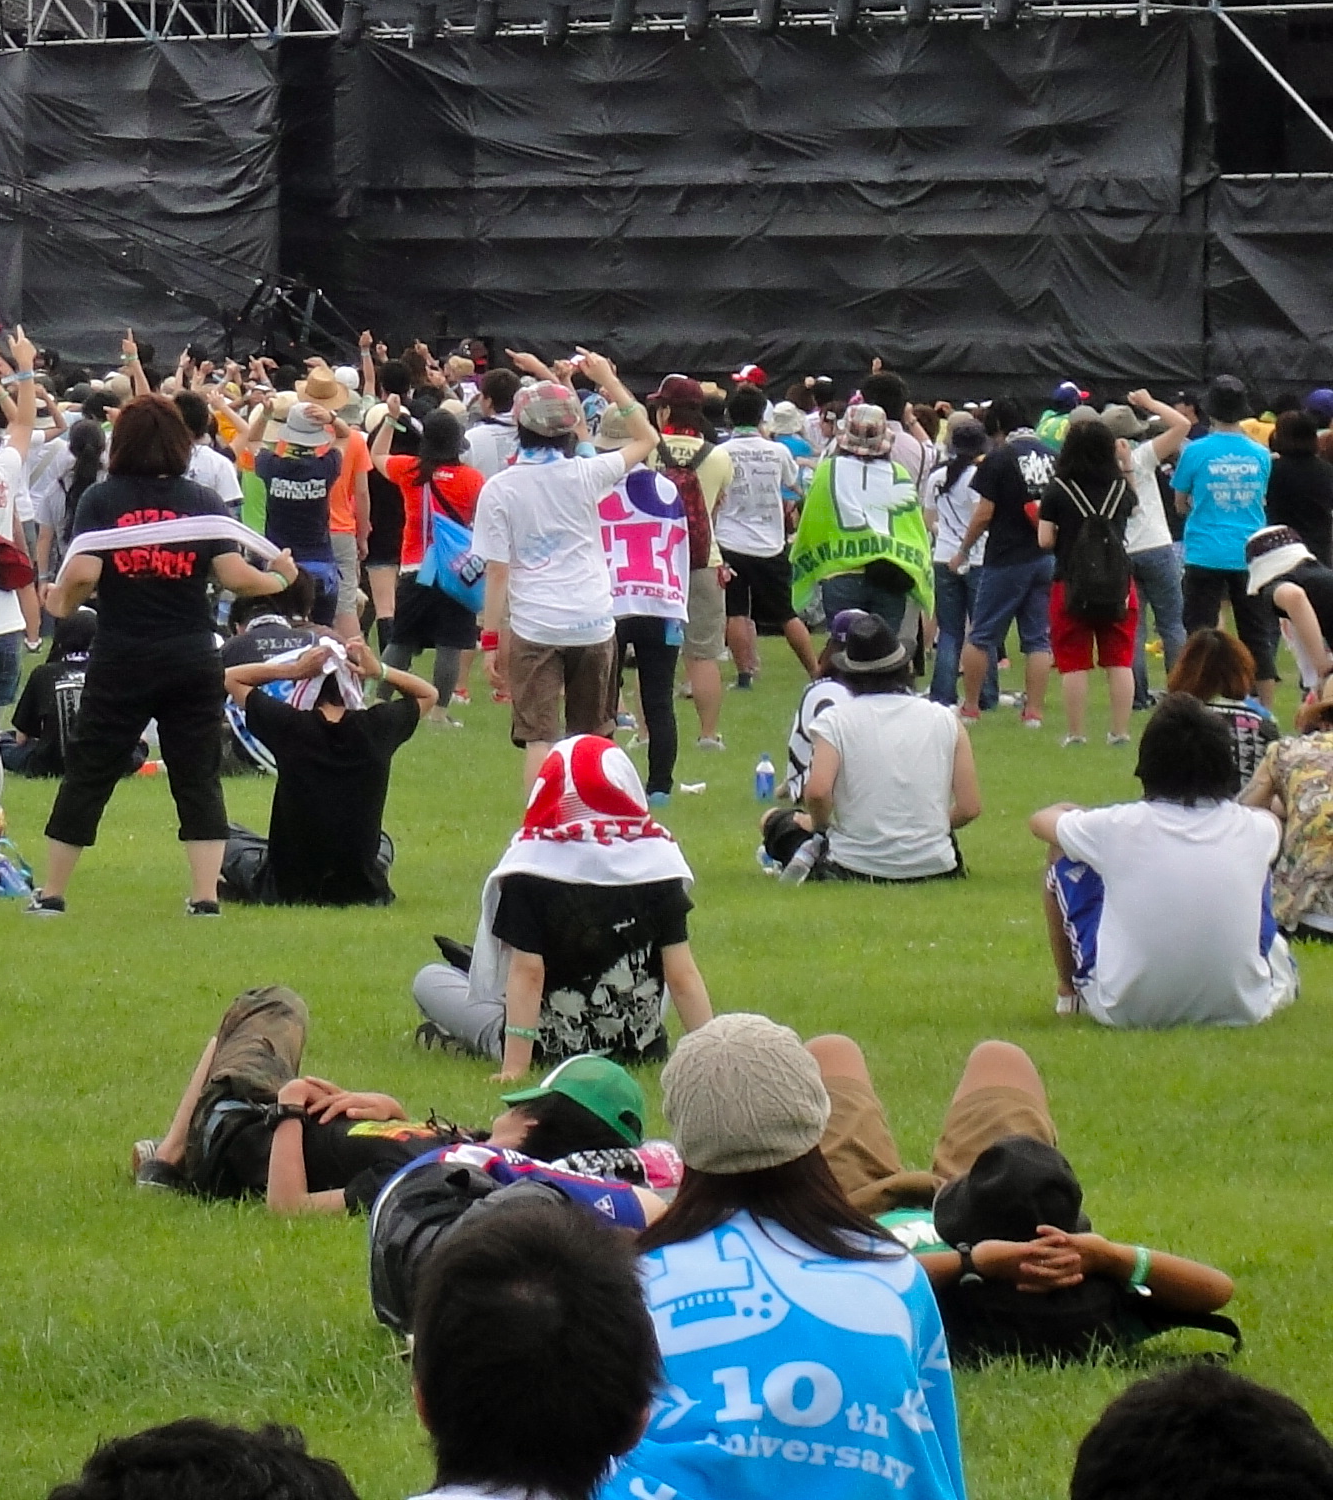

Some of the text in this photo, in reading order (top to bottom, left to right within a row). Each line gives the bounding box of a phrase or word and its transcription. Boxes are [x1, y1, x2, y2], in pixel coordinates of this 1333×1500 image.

[631, 586, 665, 598] FES
[256, 637, 303, 650] PLAY
[712, 1360, 889, 1439] 10th
[711, 1425, 916, 1490] niversary
